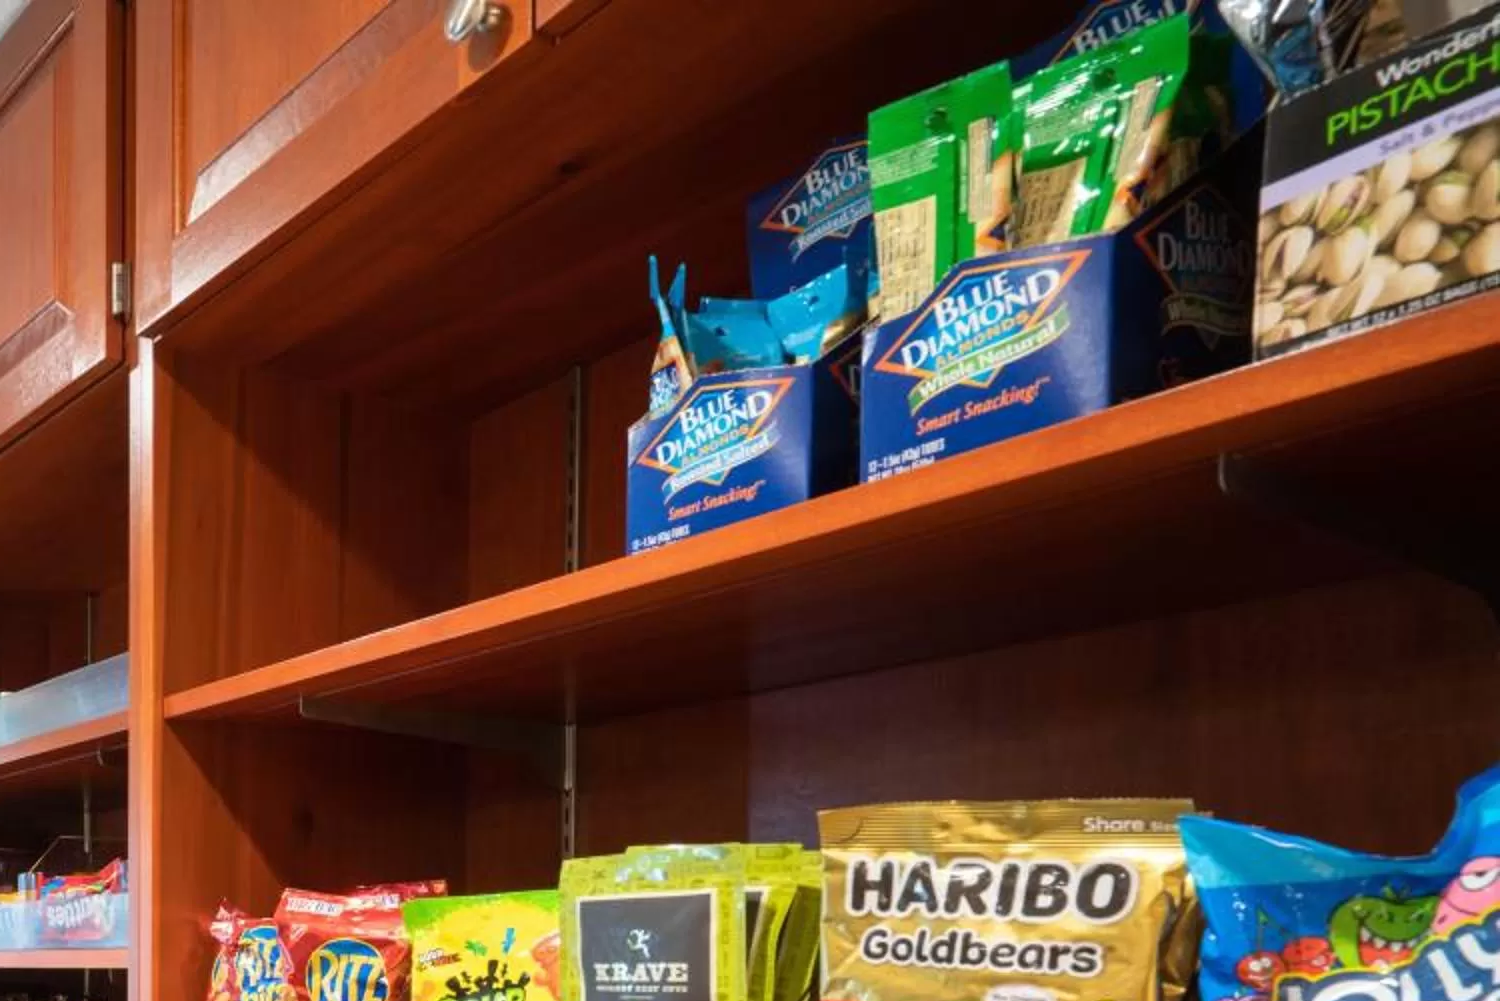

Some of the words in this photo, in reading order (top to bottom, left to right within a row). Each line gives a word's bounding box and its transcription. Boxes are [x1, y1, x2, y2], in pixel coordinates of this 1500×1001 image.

[805, 149, 860, 195] BLUE
[901, 268, 1061, 371] DIAMOND
[933, 270, 1012, 328] BLUE
[978, 319, 1057, 370] Natural
[655, 390, 774, 466] DIAMOND
[679, 389, 739, 434] BLUE
[916, 410, 960, 436] Smart
[1083, 816, 1144, 833] Share
[848, 857, 1134, 922] HARIBO
[593, 962, 689, 983] KRAVE
[863, 929, 1100, 974] Goldbears
